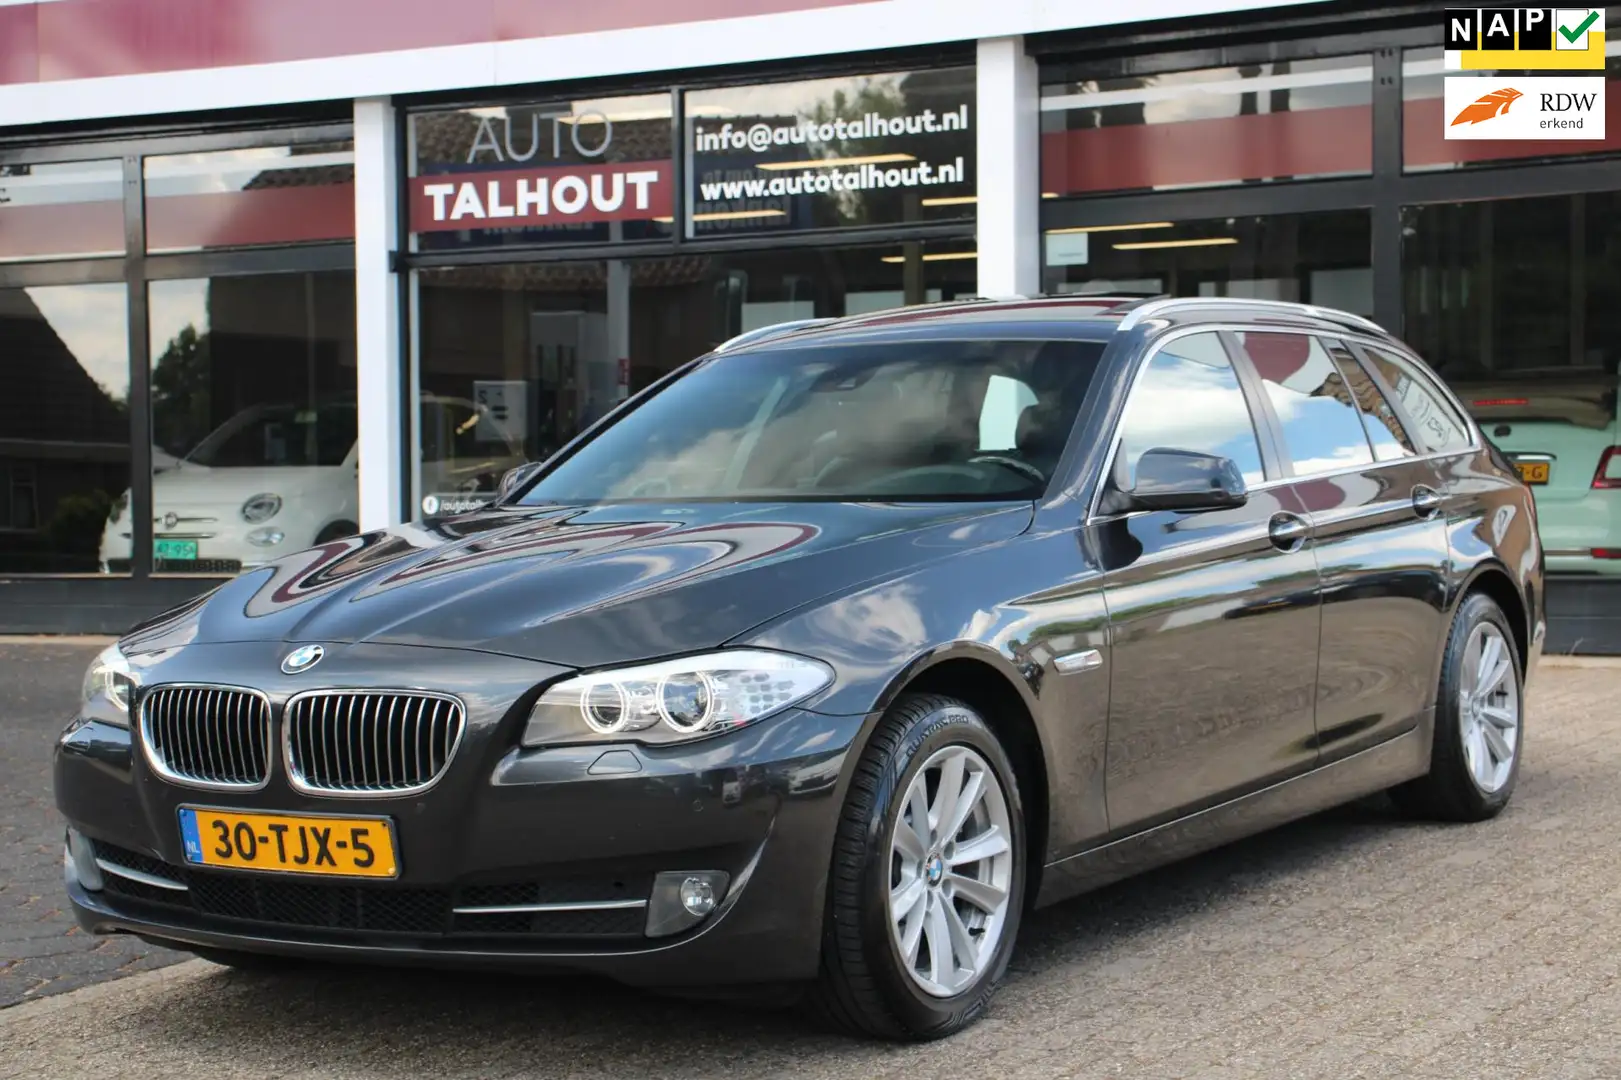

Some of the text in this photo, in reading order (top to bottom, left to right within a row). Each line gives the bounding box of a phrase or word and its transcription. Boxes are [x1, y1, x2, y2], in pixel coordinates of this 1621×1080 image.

[465, 108, 614, 164] AUTO
[695, 104, 968, 153] info@autotalhout.nl
[423, 170, 659, 221] TALHOUT
[700, 156, 964, 200] www.autotalhout.nl
[212, 819, 375, 868] 30-TJX-5
